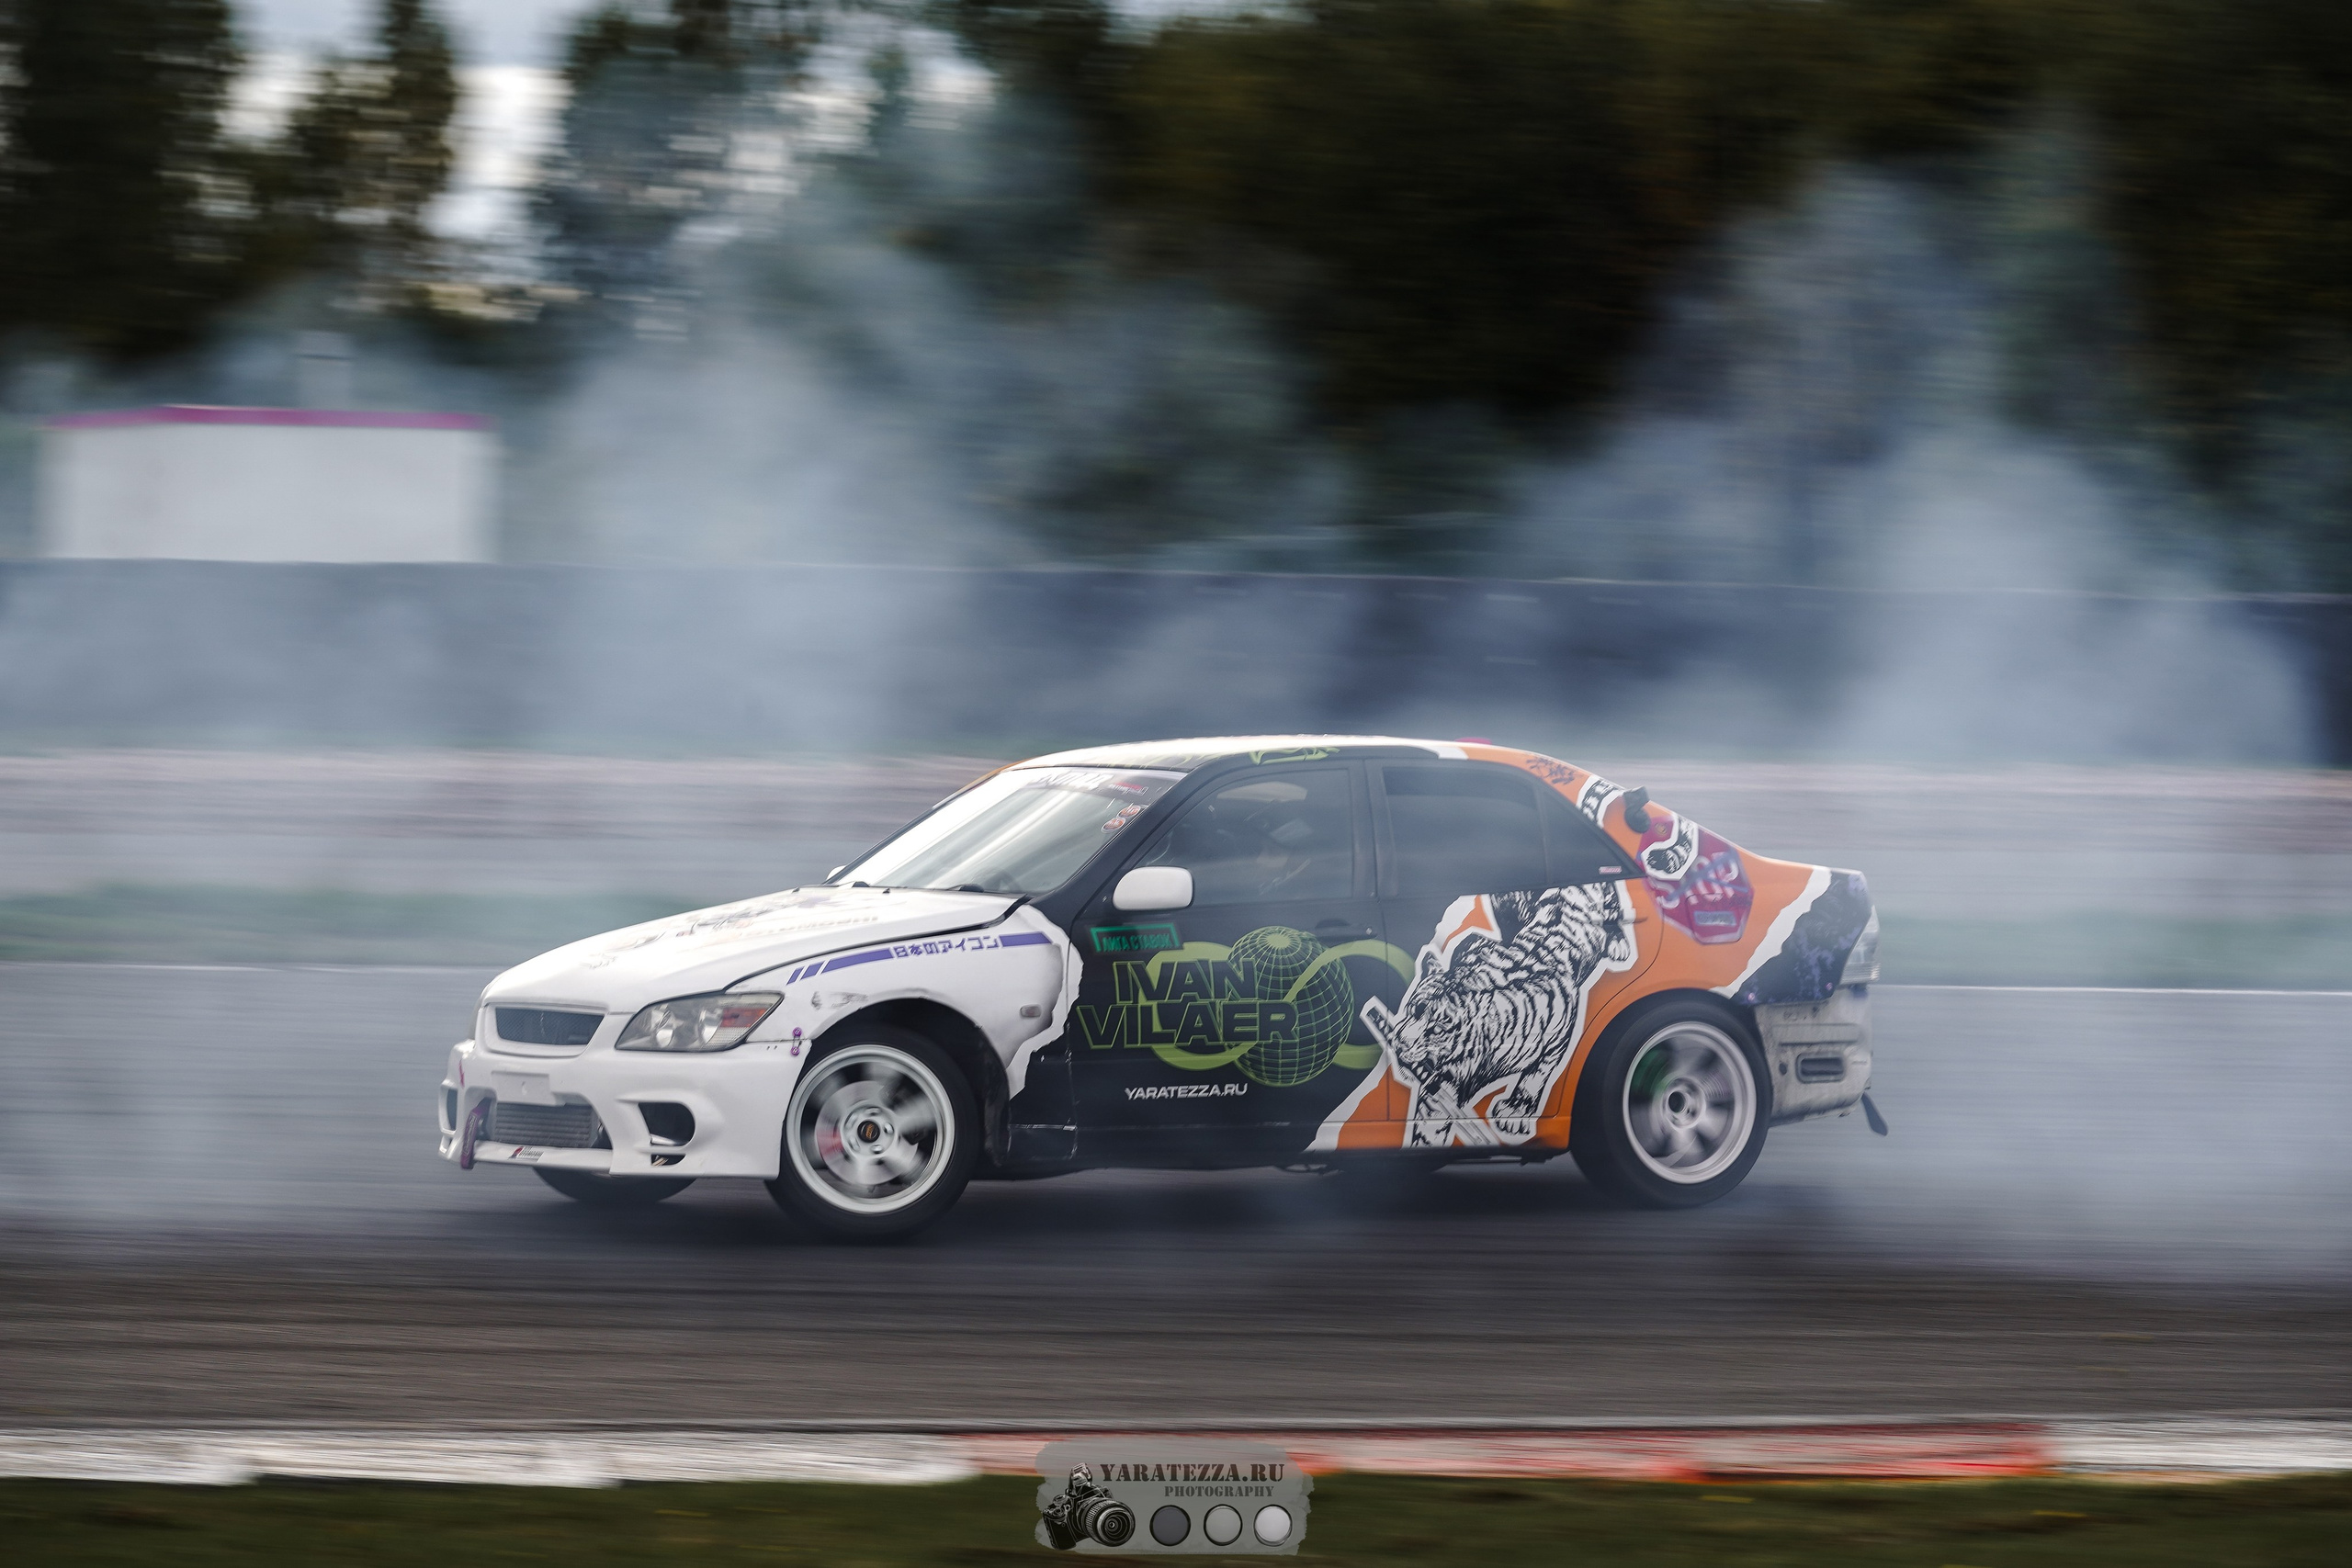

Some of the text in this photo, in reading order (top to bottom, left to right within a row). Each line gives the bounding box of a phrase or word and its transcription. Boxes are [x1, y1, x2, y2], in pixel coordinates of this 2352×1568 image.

[1113, 958, 1260, 1004] IVAN
[1076, 999, 1299, 1049] VILAER
[1124, 1082, 1249, 1100] YARATEZZA.RU
